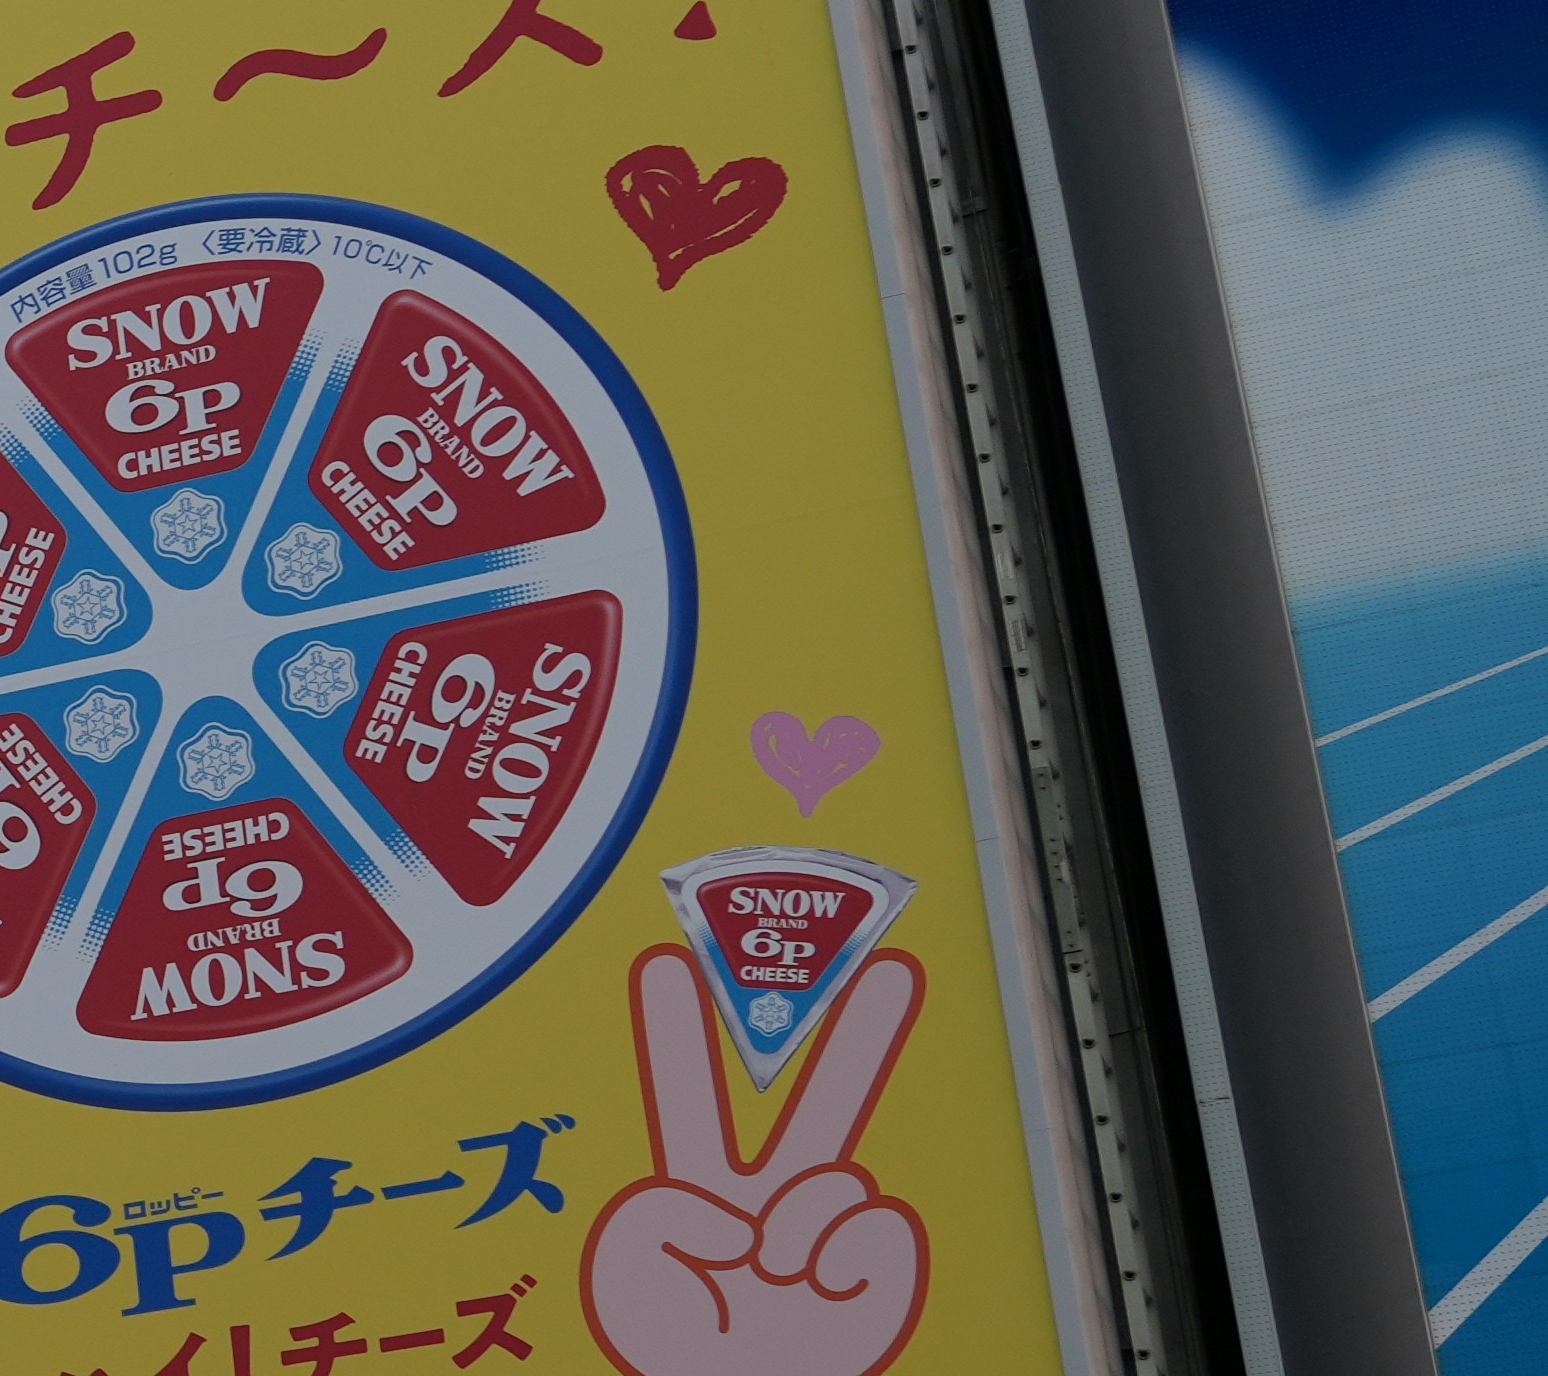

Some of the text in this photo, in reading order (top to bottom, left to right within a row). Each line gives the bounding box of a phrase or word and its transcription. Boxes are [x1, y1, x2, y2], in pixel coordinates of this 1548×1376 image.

[66, 278, 270, 371] SNOW
[126, 345, 216, 379] BRAND
[401, 335, 575, 496] SNOW
[417, 407, 484, 479] BRAND
[118, 429, 241, 479] CHEESE
[322, 461, 415, 560] CHEESE
[355, 641, 427, 764] CHEESE
[465, 689, 516, 779] BRAND
[467, 642, 591, 859] SNOW
[162, 812, 290, 861] CHEESE
[728, 887, 846, 918] SNOW
[758, 918, 808, 929] BRAND
[187, 918, 282, 951] BRAND
[130, 931, 345, 1021] SNOW
[740, 966, 809, 983] CHEESE
[122, 1187, 224, 1220] ロッピー
